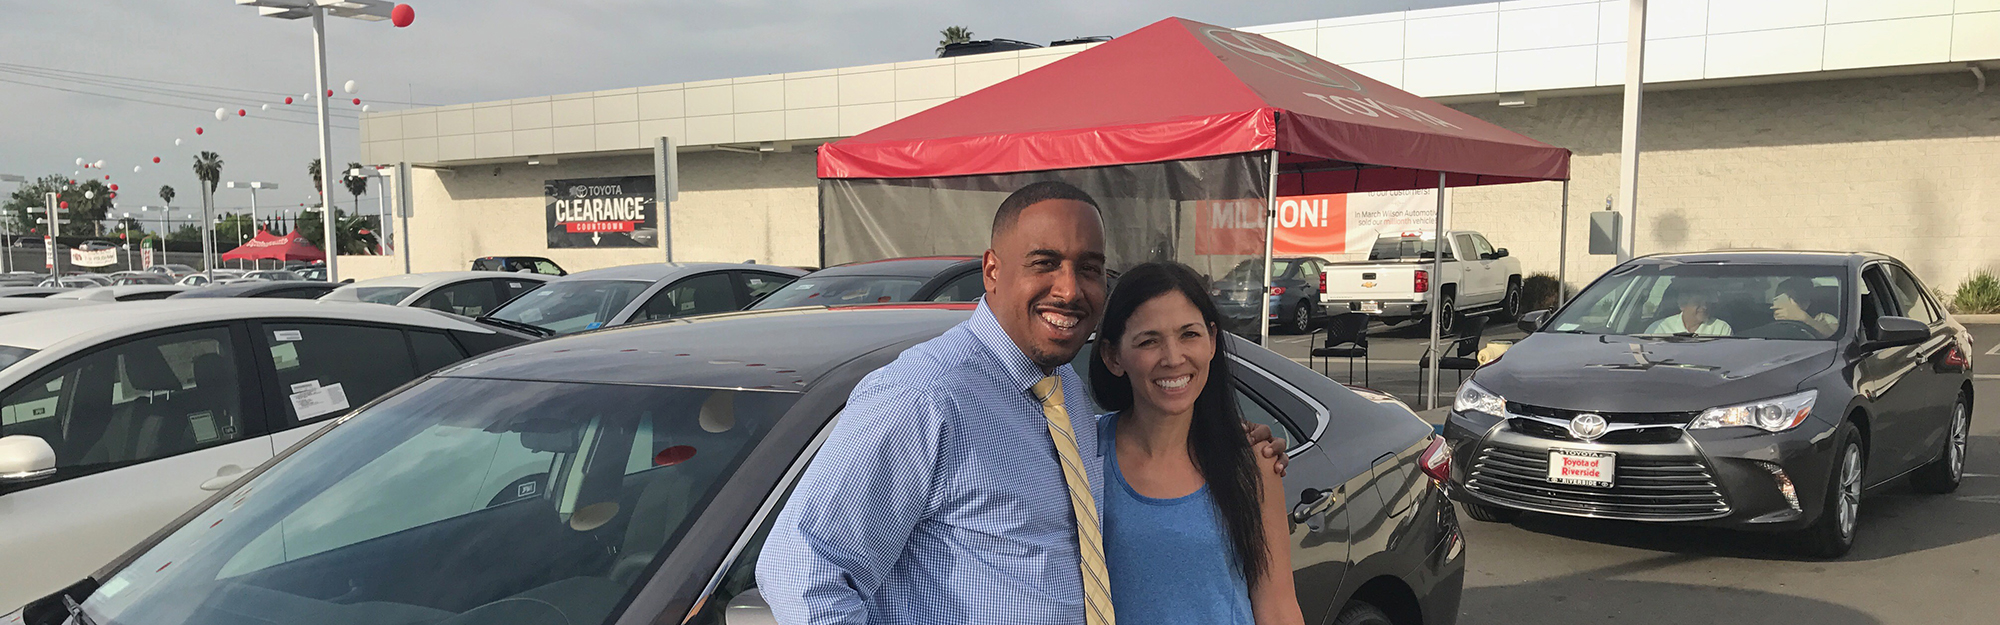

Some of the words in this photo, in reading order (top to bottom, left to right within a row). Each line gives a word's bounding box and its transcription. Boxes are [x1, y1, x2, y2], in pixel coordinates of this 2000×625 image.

[588, 185, 622, 195] TOYOTA
[555, 197, 645, 221] CLEARANCE
[1361, 210, 1381, 218] March
[1382, 210, 1403, 218] Wilson
[1404, 209, 1438, 217] Automotiv
[1384, 217, 1411, 225] millionth
[577, 223, 624, 231] COUNTDOWN
[1563, 457, 1589, 467] Toyota
[1562, 467, 1600, 477] Riverside
[1562, 478, 1597, 486] RIVERSIDE
